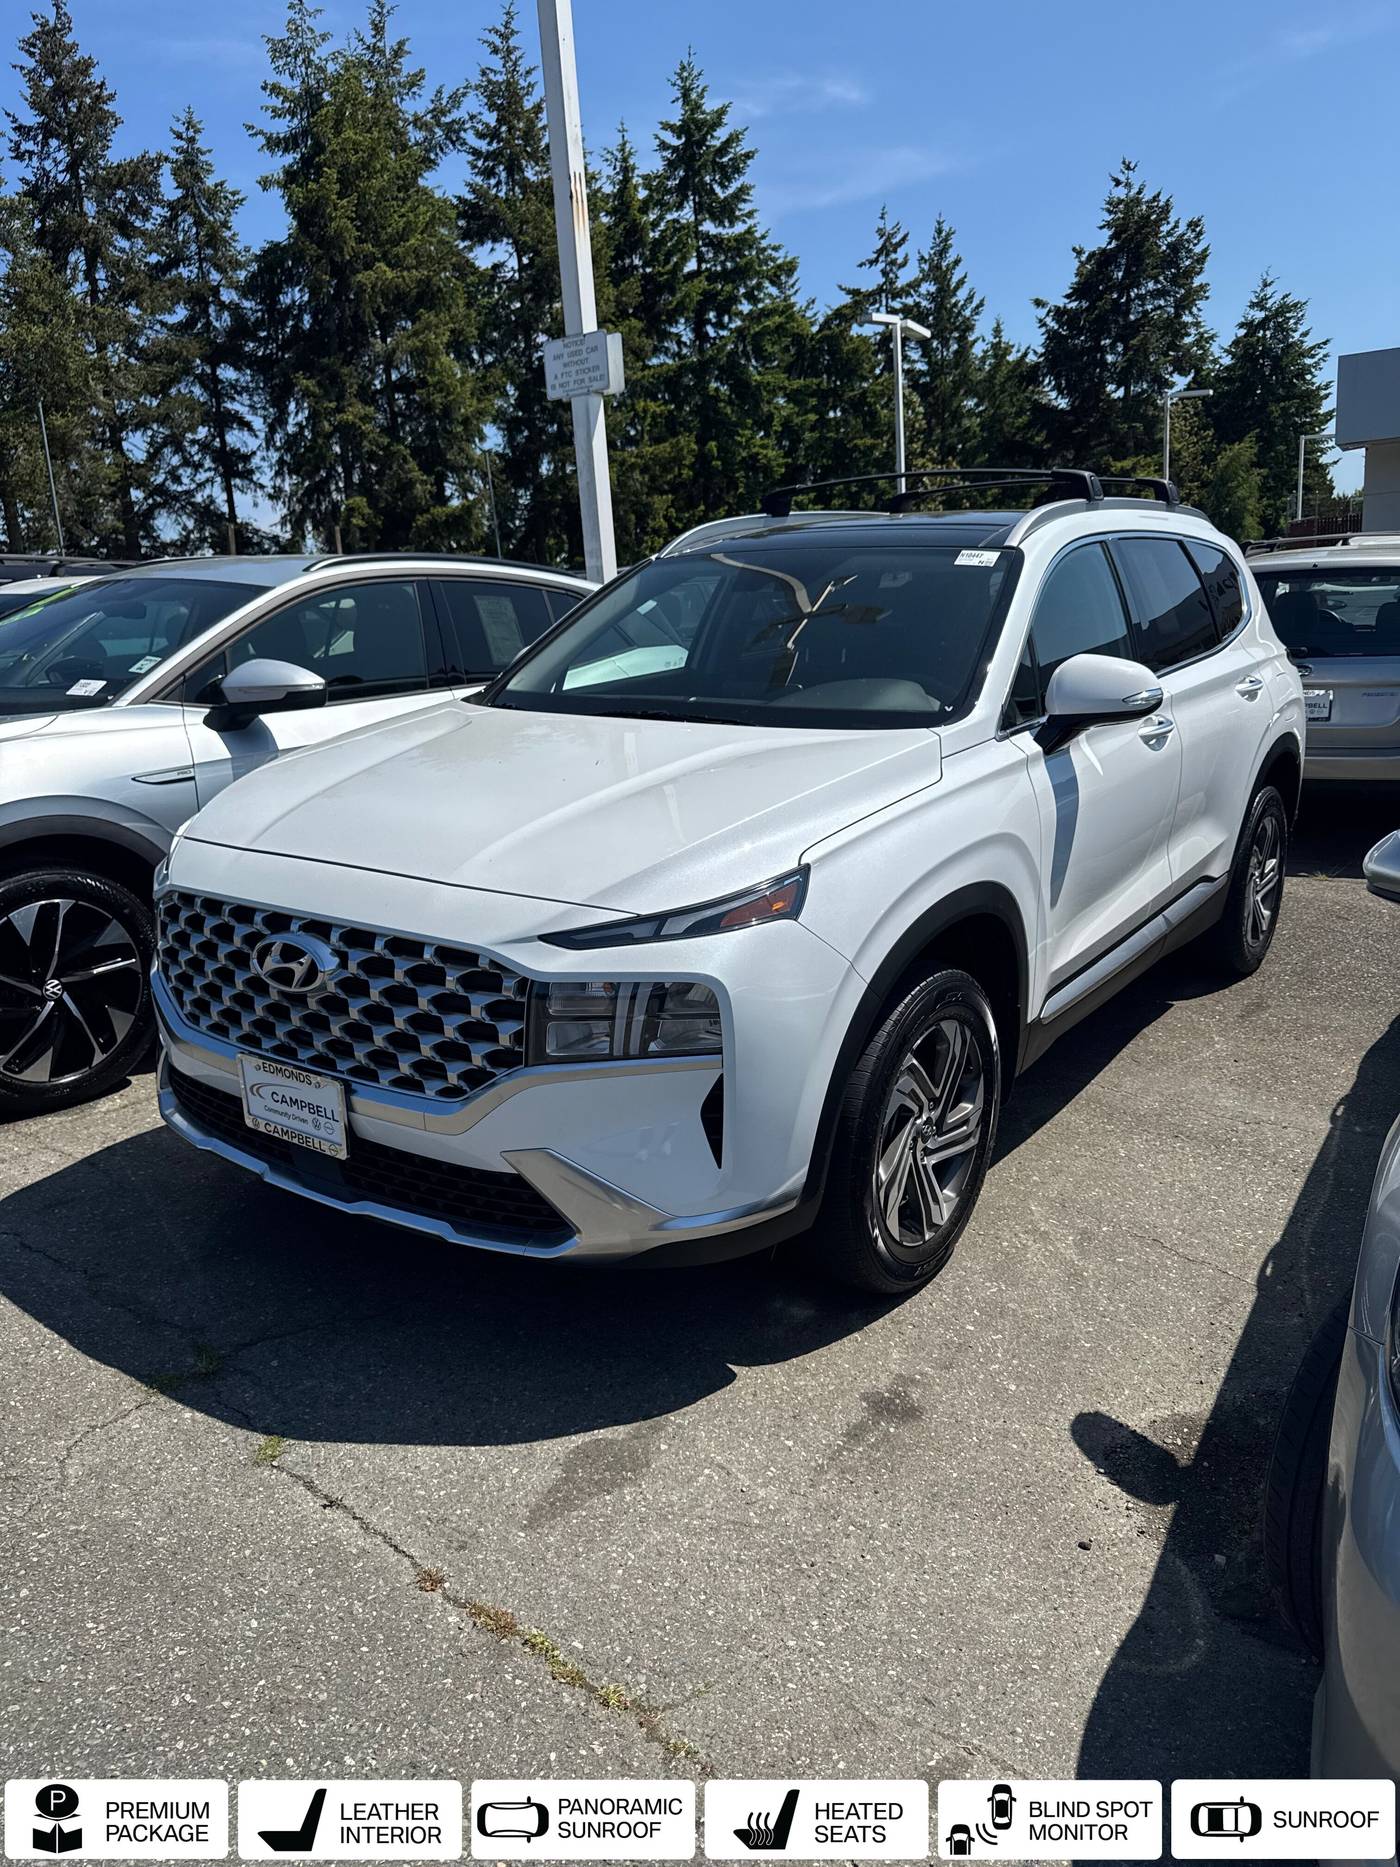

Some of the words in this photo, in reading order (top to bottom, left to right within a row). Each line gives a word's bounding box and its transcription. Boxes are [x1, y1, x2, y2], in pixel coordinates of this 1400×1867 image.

[567, 349, 583, 358] USED
[585, 345, 599, 354] CAR
[562, 357, 589, 368] WITHOUT
[575, 365, 600, 376] STICKER
[573, 378, 586, 386] FOR
[262, 1061, 312, 1086] EDMONDS
[270, 1091, 340, 1123] CAMPBELL
[263, 1122, 327, 1153] CAMPBELL
